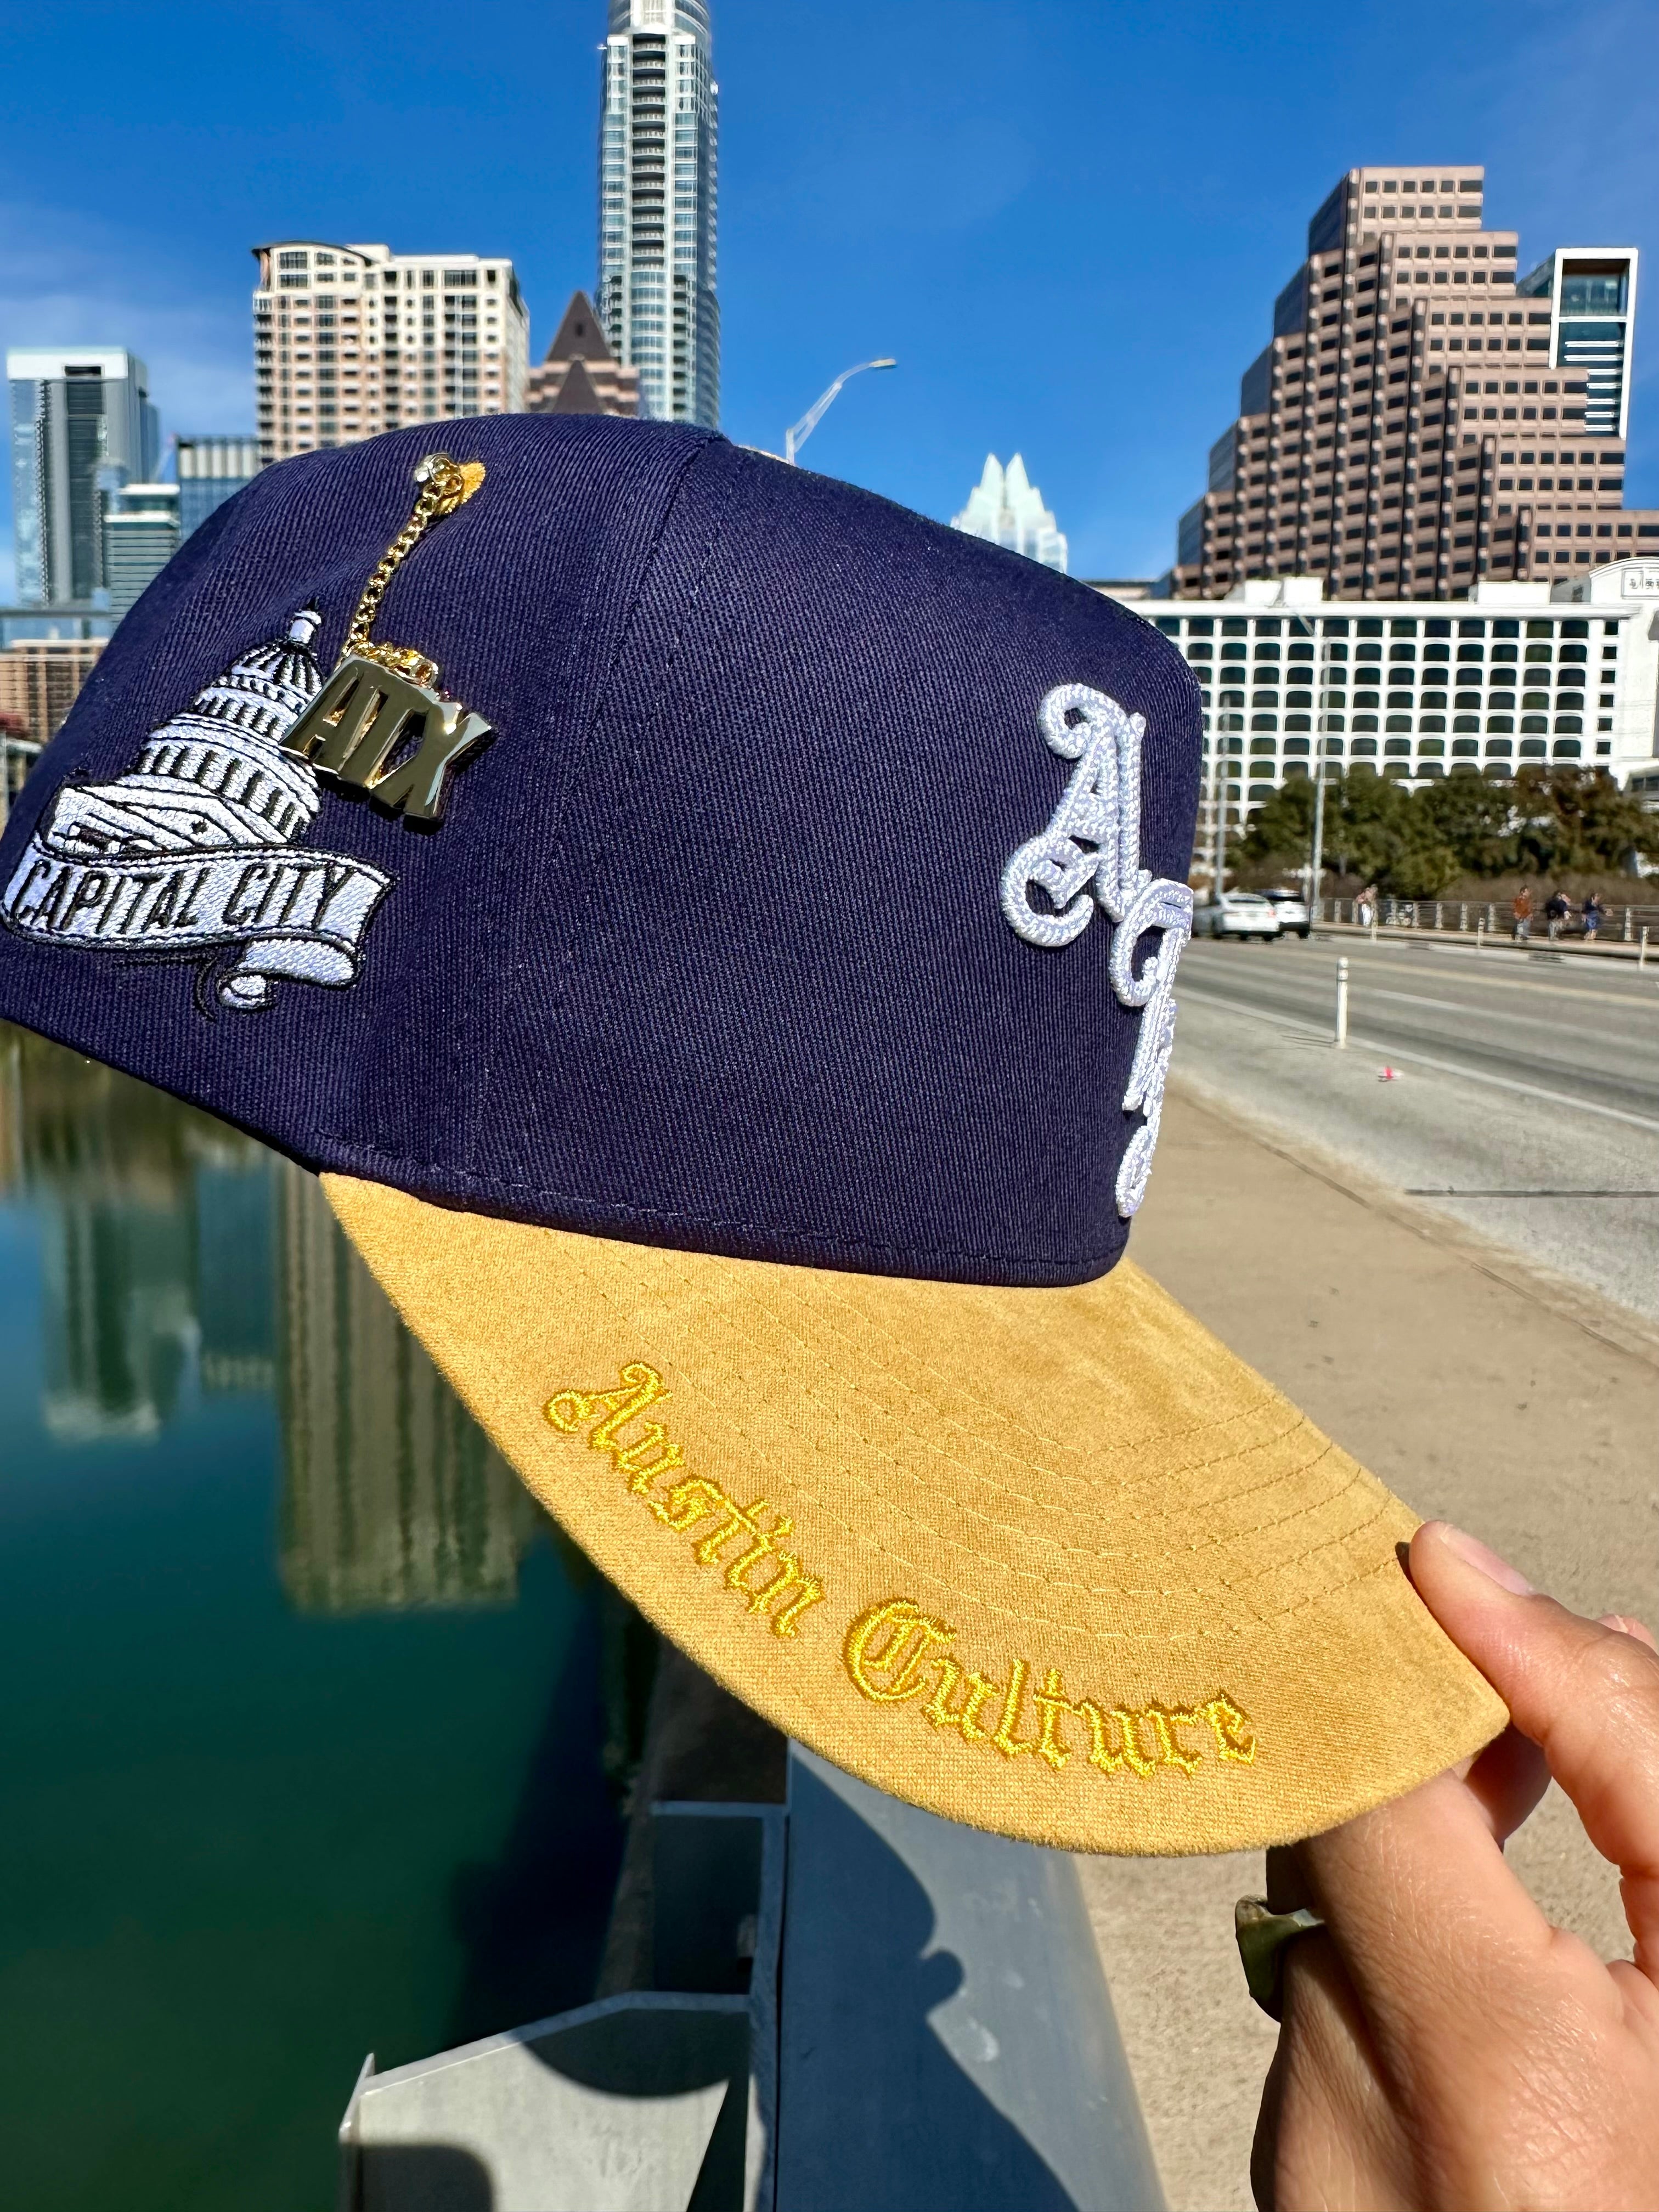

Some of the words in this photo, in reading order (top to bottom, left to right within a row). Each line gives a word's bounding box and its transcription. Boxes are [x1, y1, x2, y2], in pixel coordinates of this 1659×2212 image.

[278, 654, 494, 823] ATX
[13, 860, 211, 934] CAPITAL
[222, 862, 357, 927] CITY
[544, 1361, 823, 1638] Austin
[843, 1598, 1256, 1778] Culture
